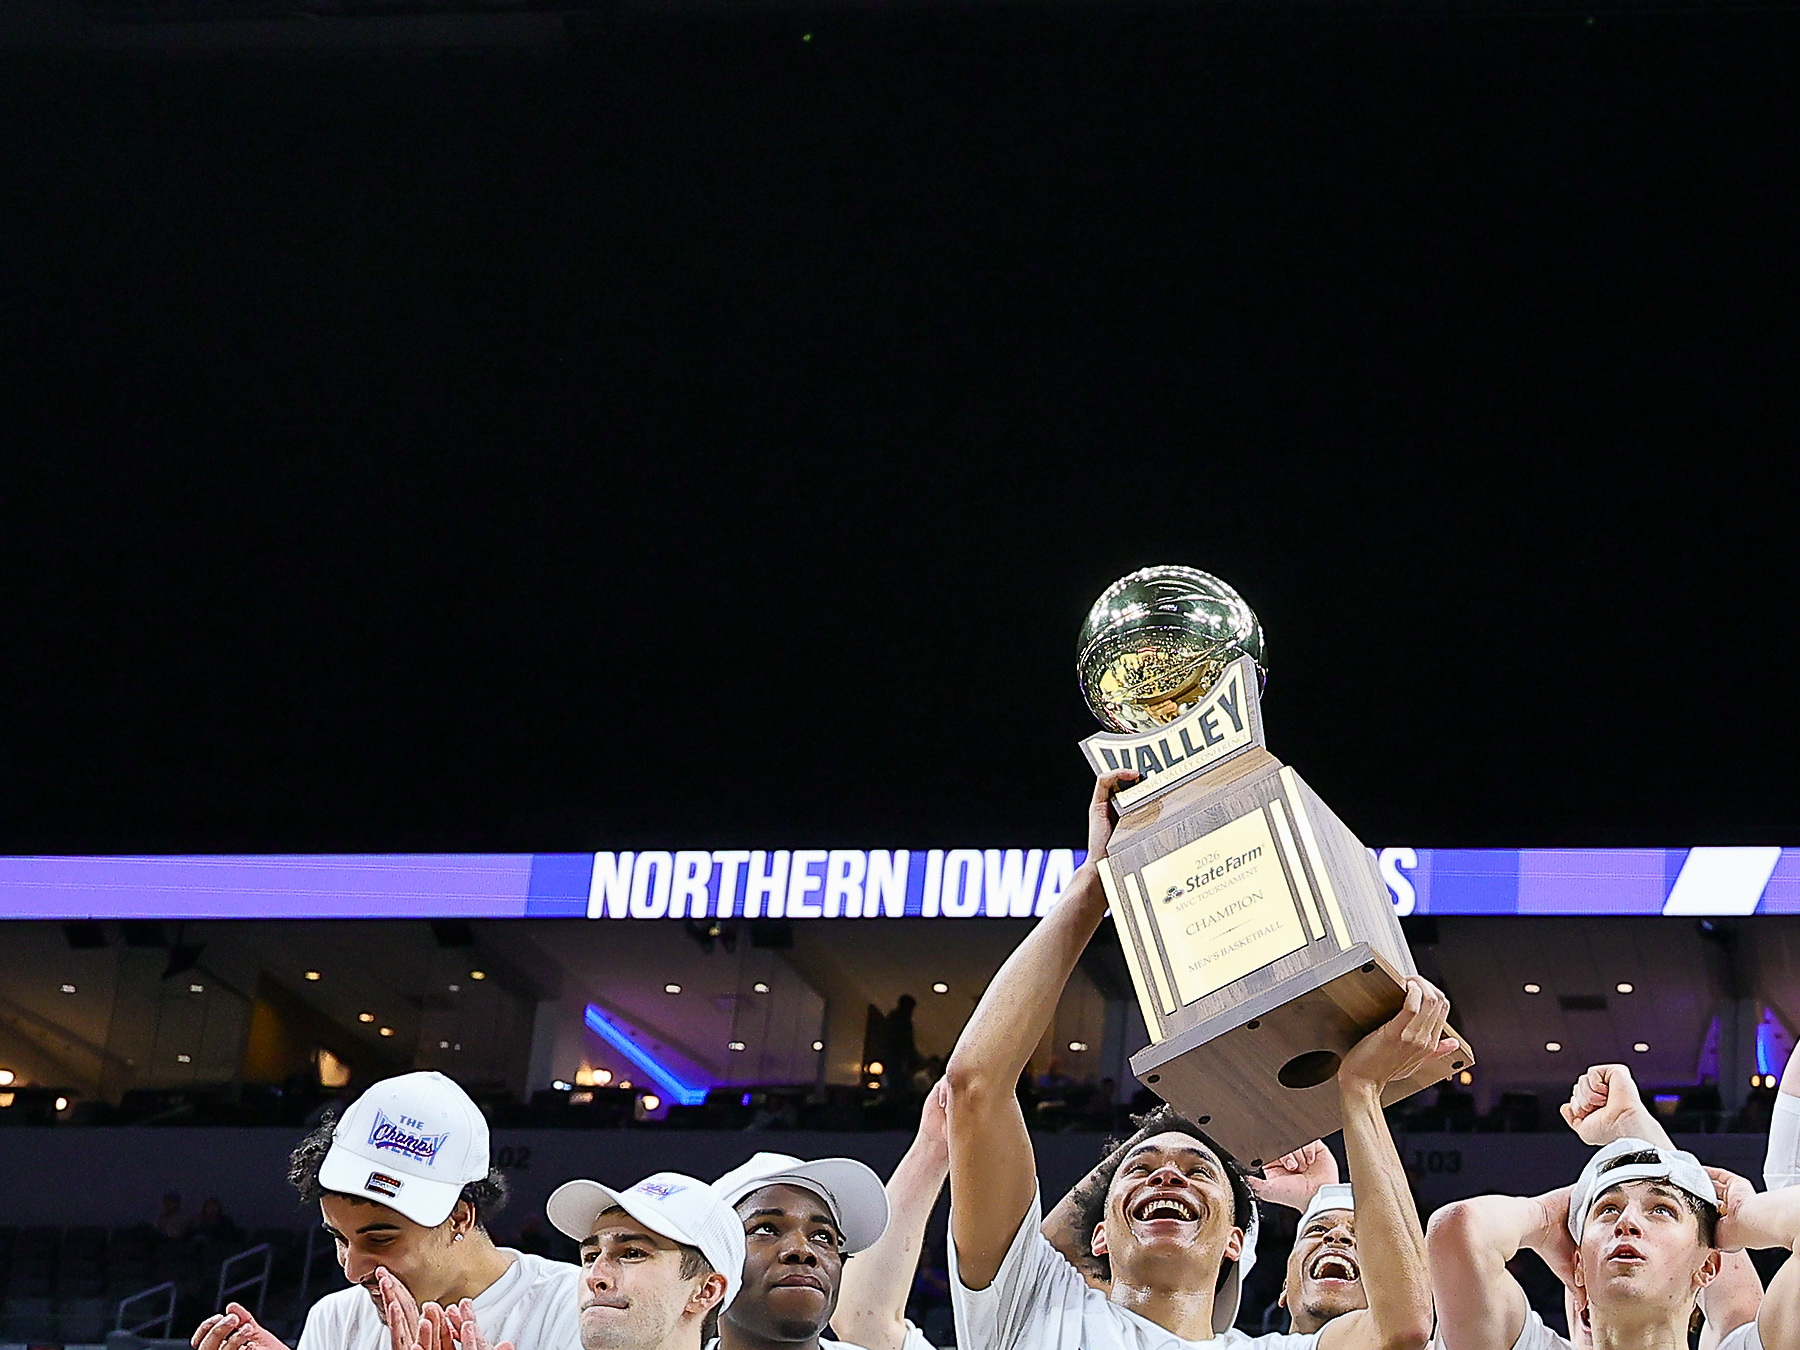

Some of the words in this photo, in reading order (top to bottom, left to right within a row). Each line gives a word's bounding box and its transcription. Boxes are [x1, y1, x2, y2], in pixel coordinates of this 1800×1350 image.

[1100, 676, 1244, 781] VALLEY
[587, 849, 910, 918] NORTHERN
[921, 849, 1075, 918] IOWA
[1195, 850, 1221, 870] 2026
[1176, 897, 1197, 913] MVC
[1197, 866, 1260, 904] TOURNAMENT
[1185, 889, 1264, 937] CHAMPION
[1188, 950, 1220, 973] MEN'S
[1220, 921, 1283, 959] BASKETBALL
[373, 1124, 435, 1157] Champs
[400, 1114, 424, 1130] THE
